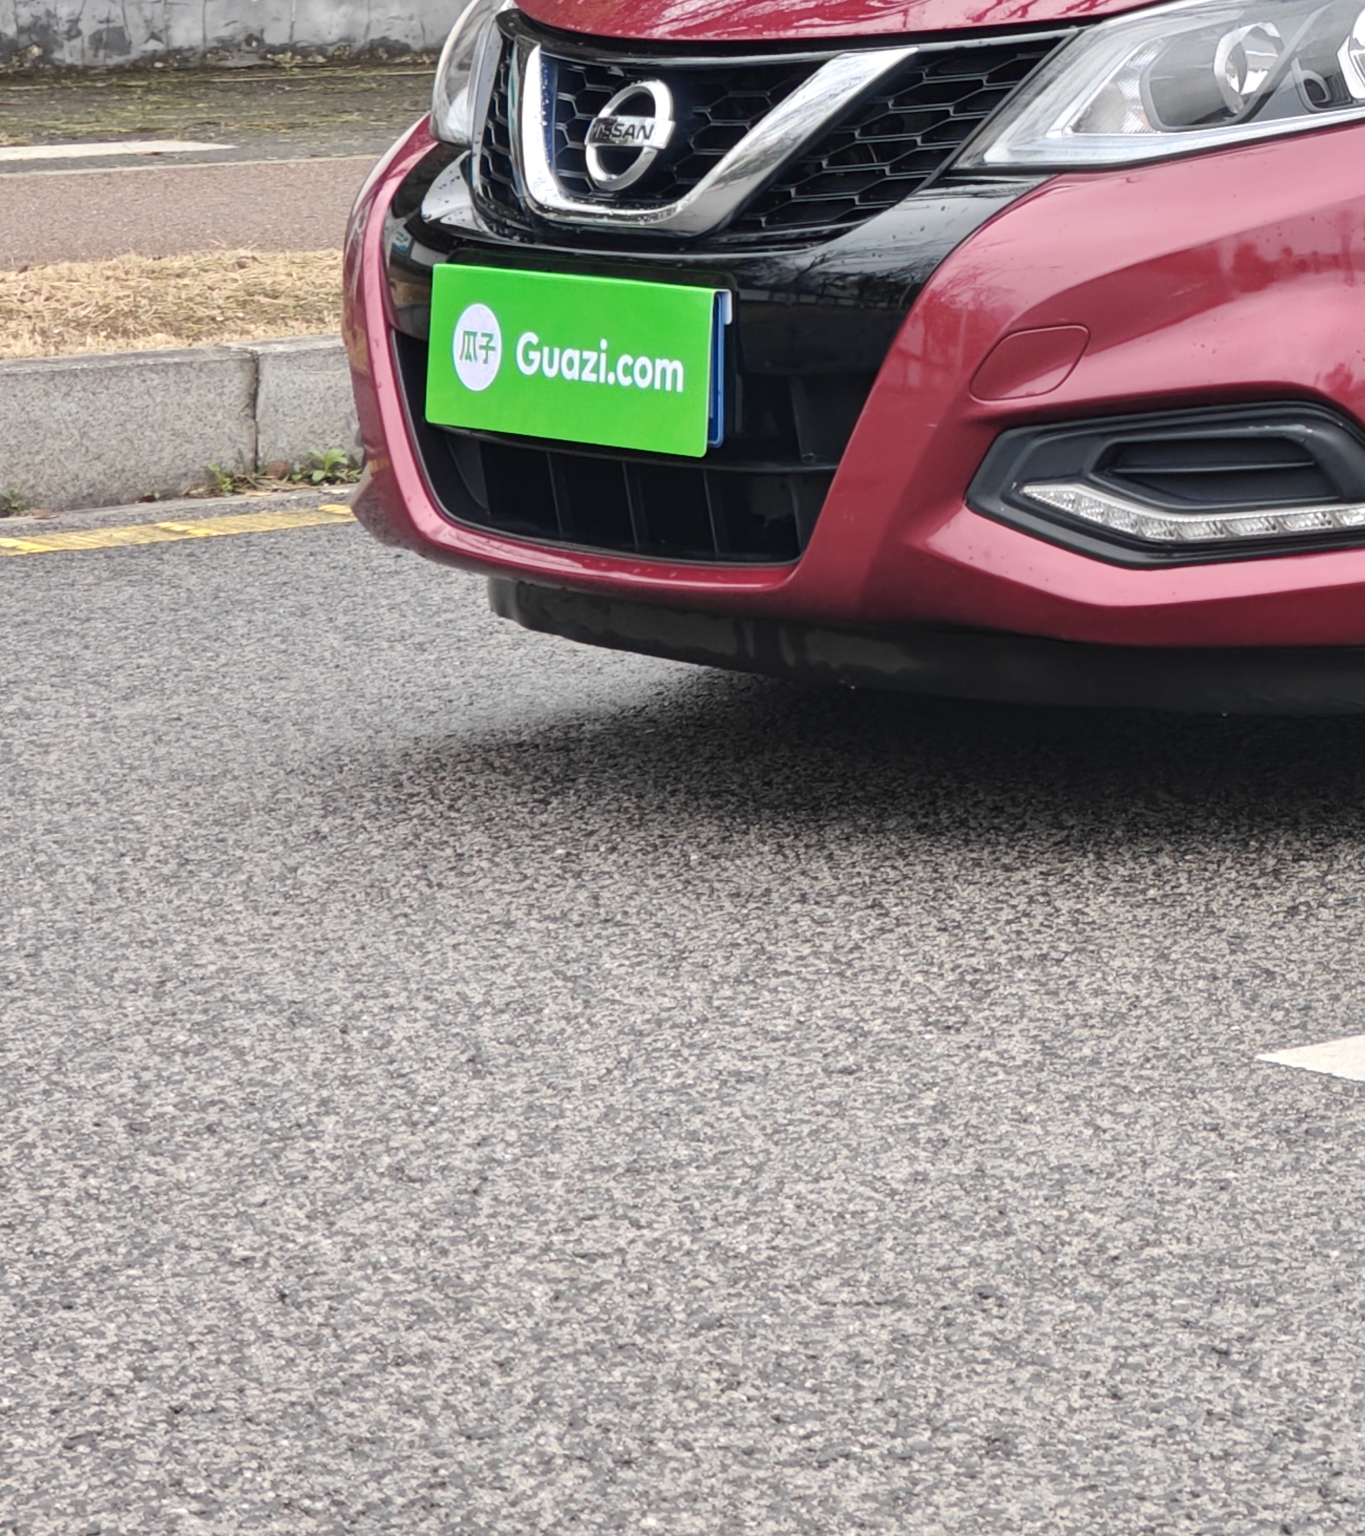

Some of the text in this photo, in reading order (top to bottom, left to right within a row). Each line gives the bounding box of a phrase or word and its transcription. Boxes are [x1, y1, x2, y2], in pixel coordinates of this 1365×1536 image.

[589, 121, 655, 142] NISSAN
[460, 330, 496, 364] 瓜子
[516, 332, 684, 392] Guazi.com
